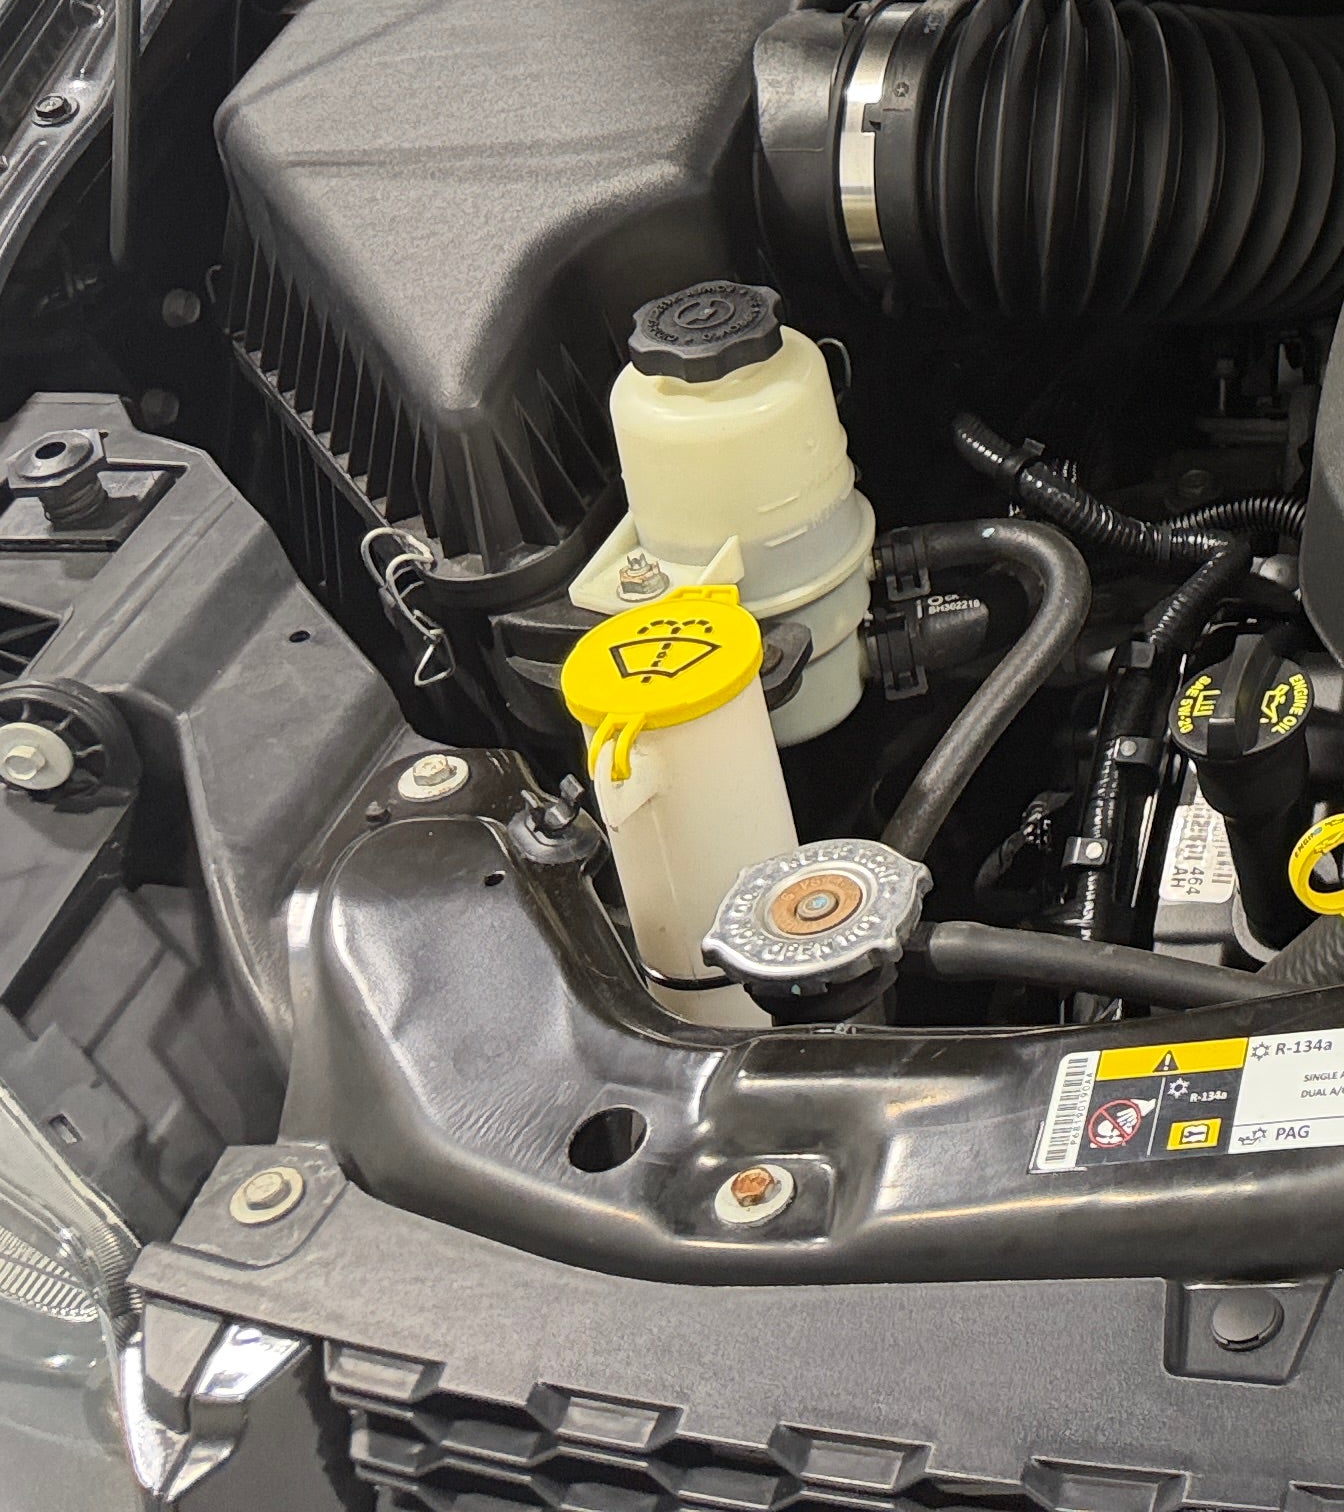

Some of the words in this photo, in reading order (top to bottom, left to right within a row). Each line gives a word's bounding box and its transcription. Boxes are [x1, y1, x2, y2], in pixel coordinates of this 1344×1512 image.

[1185, 675, 1213, 697] SAE
[1289, 673, 1309, 717] ENGINE
[1271, 715, 1299, 736] OIL
[1275, 1039, 1333, 1056] R-134a
[1303, 1070, 1339, 1083] SINGLE
[1300, 1088, 1328, 1099] DUAL
[1275, 1124, 1311, 1140] PAG
